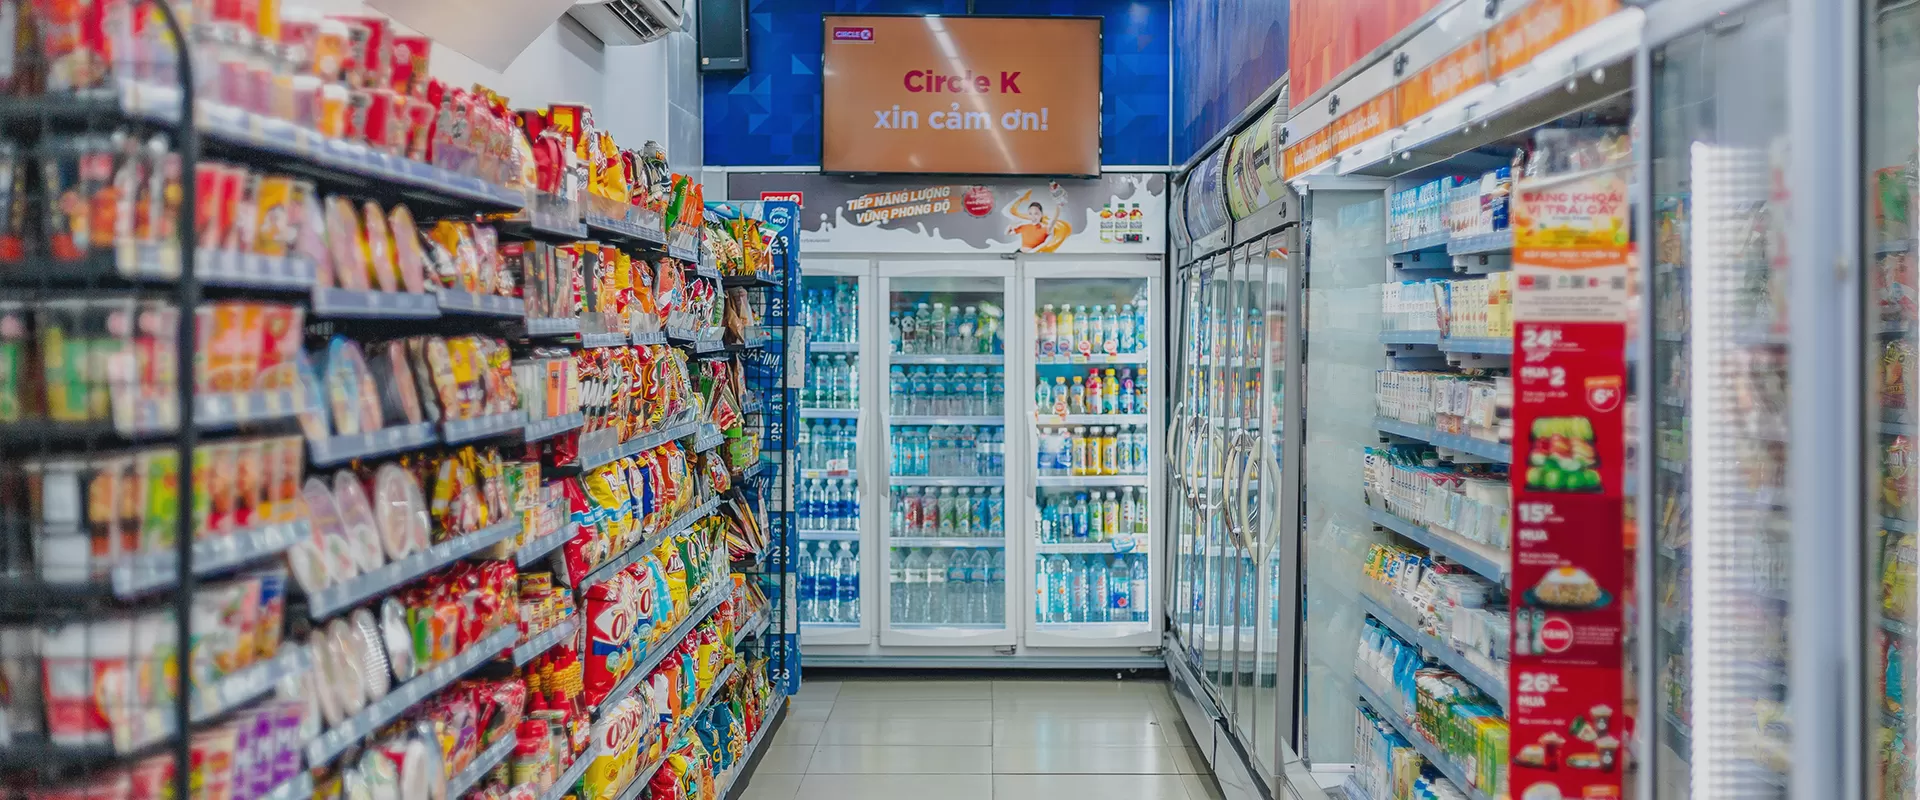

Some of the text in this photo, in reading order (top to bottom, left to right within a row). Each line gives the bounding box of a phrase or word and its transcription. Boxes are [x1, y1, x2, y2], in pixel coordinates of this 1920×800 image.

[904, 70, 1021, 94] Circle K
[874, 102, 1049, 131] xin cảm ơn!
[846, 195, 873, 211] TIẾP
[874, 191, 908, 207] NĂNG
[910, 186, 950, 202] LƯỢNG
[890, 205, 930, 219] PHONG
[933, 199, 950, 214] ĐỘ
